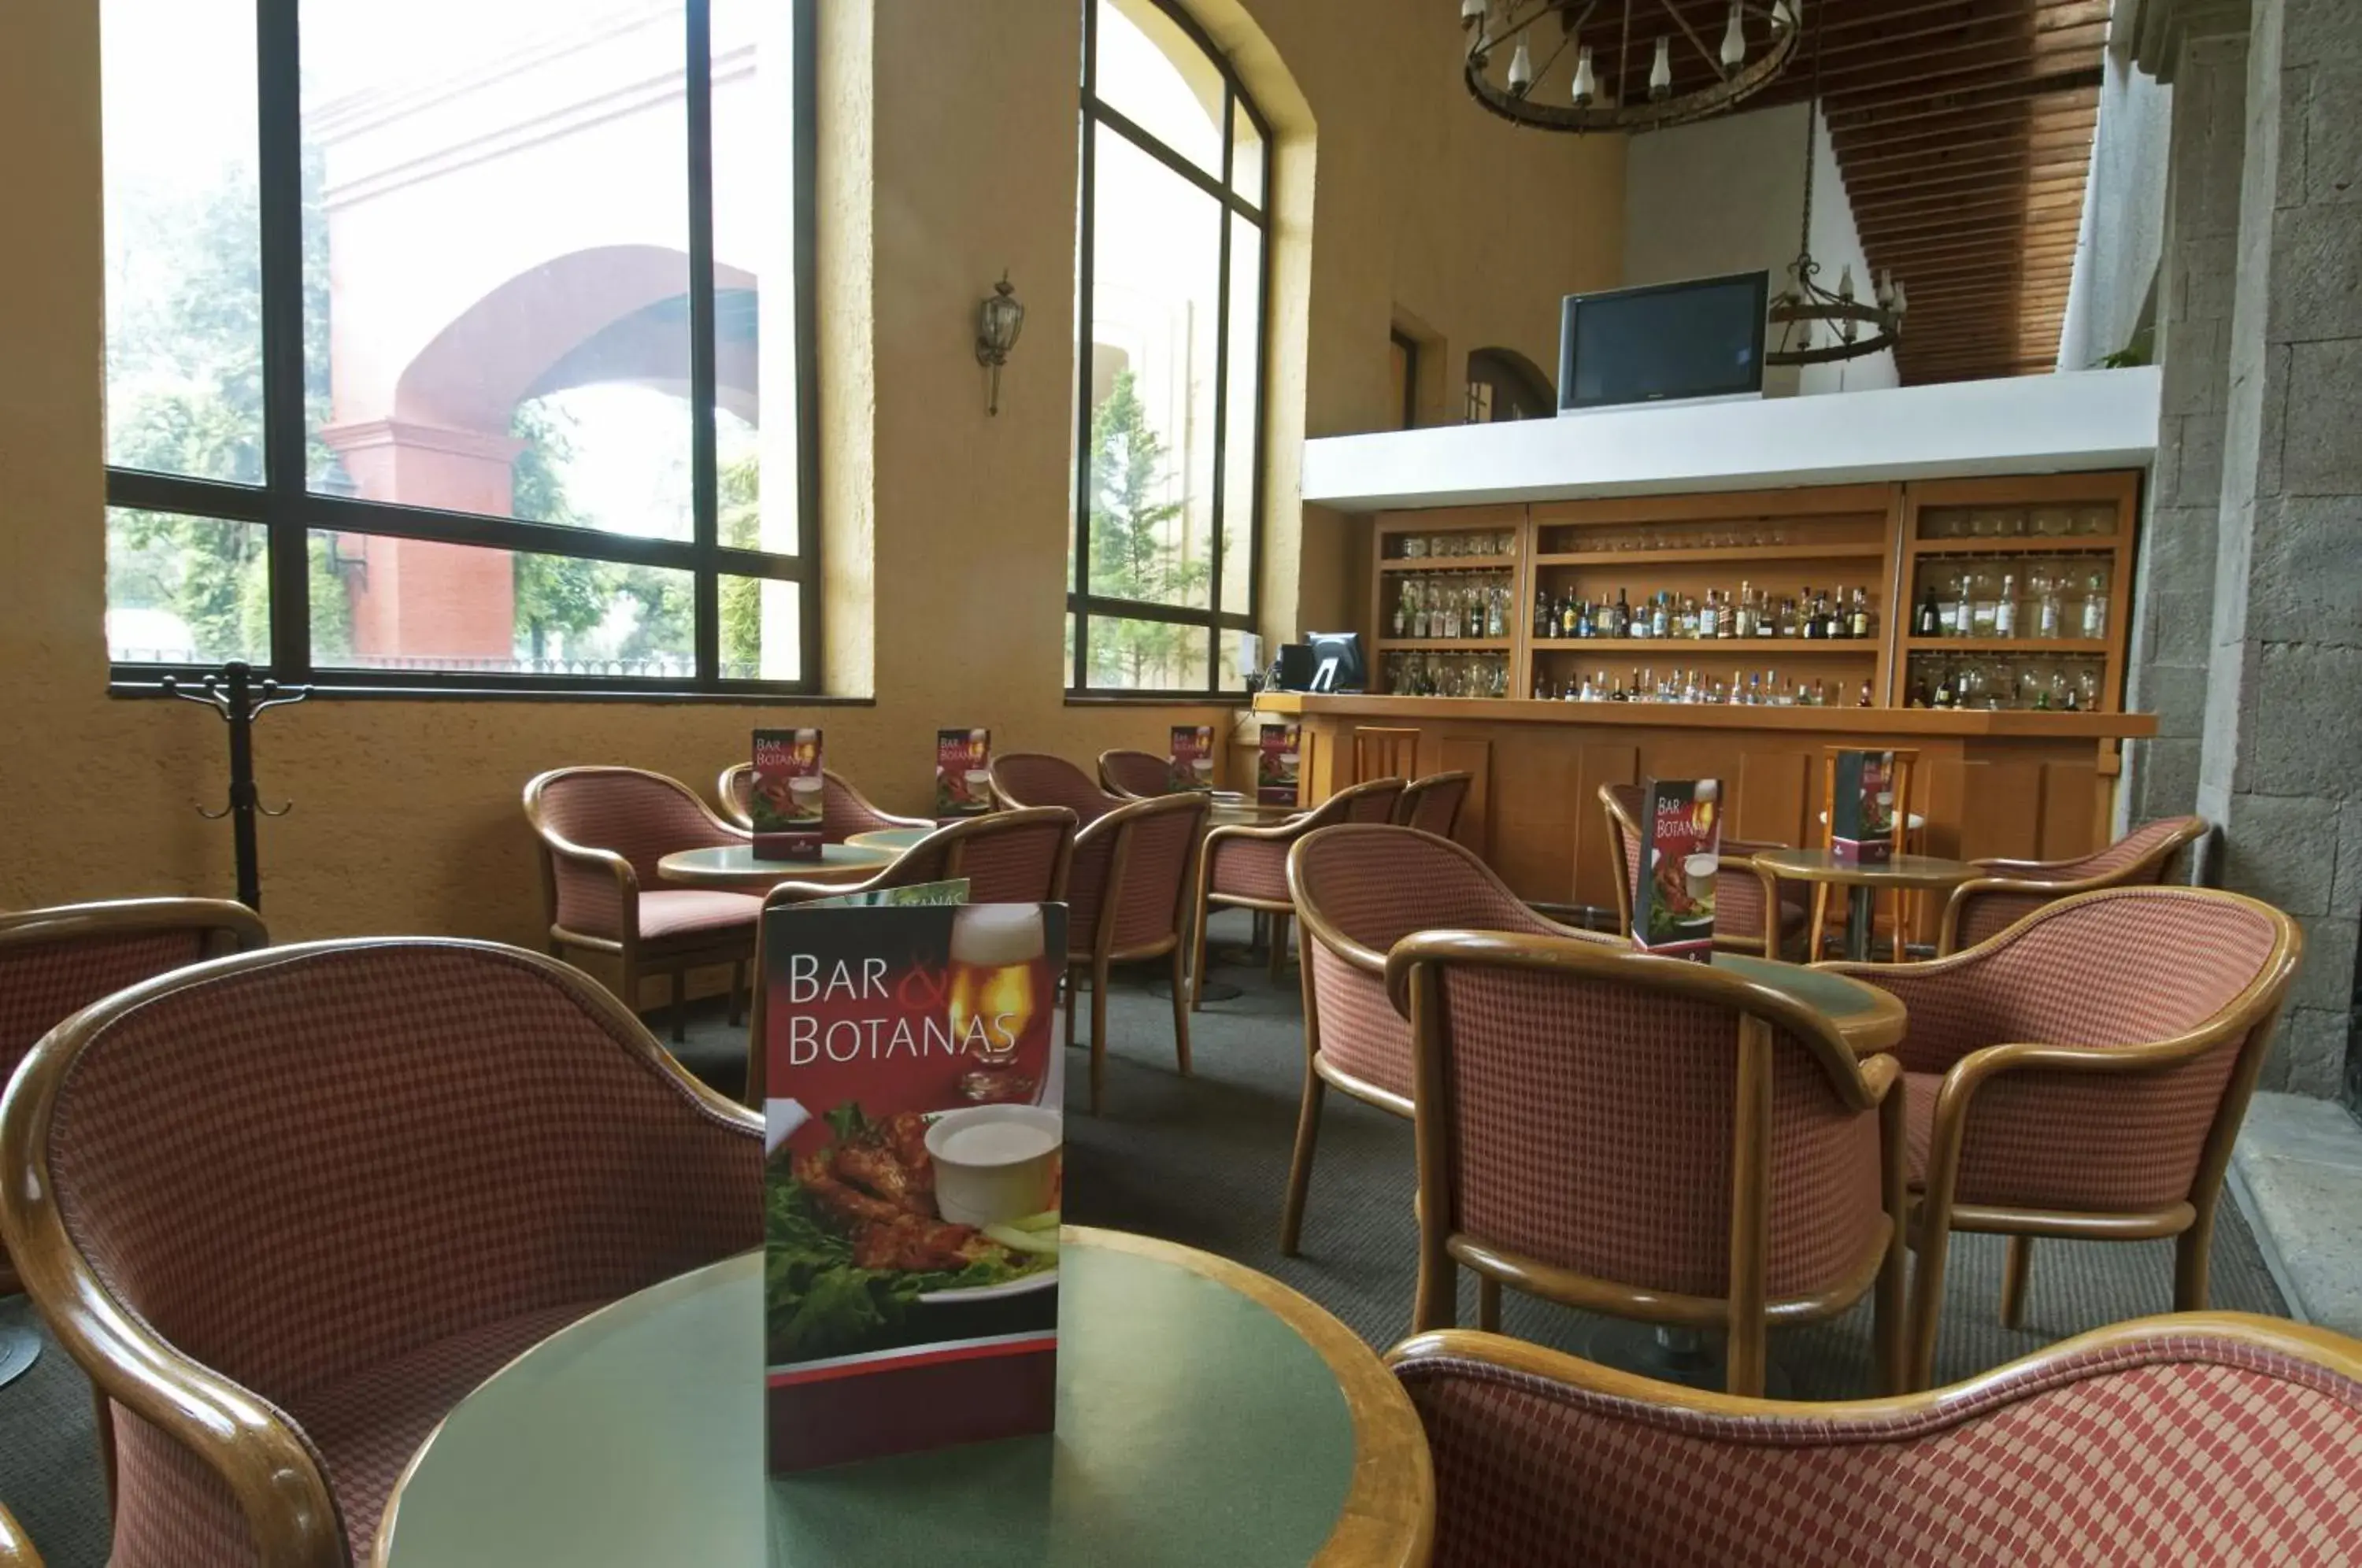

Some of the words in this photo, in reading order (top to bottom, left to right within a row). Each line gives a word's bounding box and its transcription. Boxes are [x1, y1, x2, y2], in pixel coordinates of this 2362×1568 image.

[757, 738, 780, 752] BAR
[757, 753, 810, 767] BOTAN
[1657, 797, 1679, 815] BAR
[790, 954, 888, 1004] BAR
[897, 951, 947, 1010] &
[790, 1012, 1016, 1065] BOTANAS
